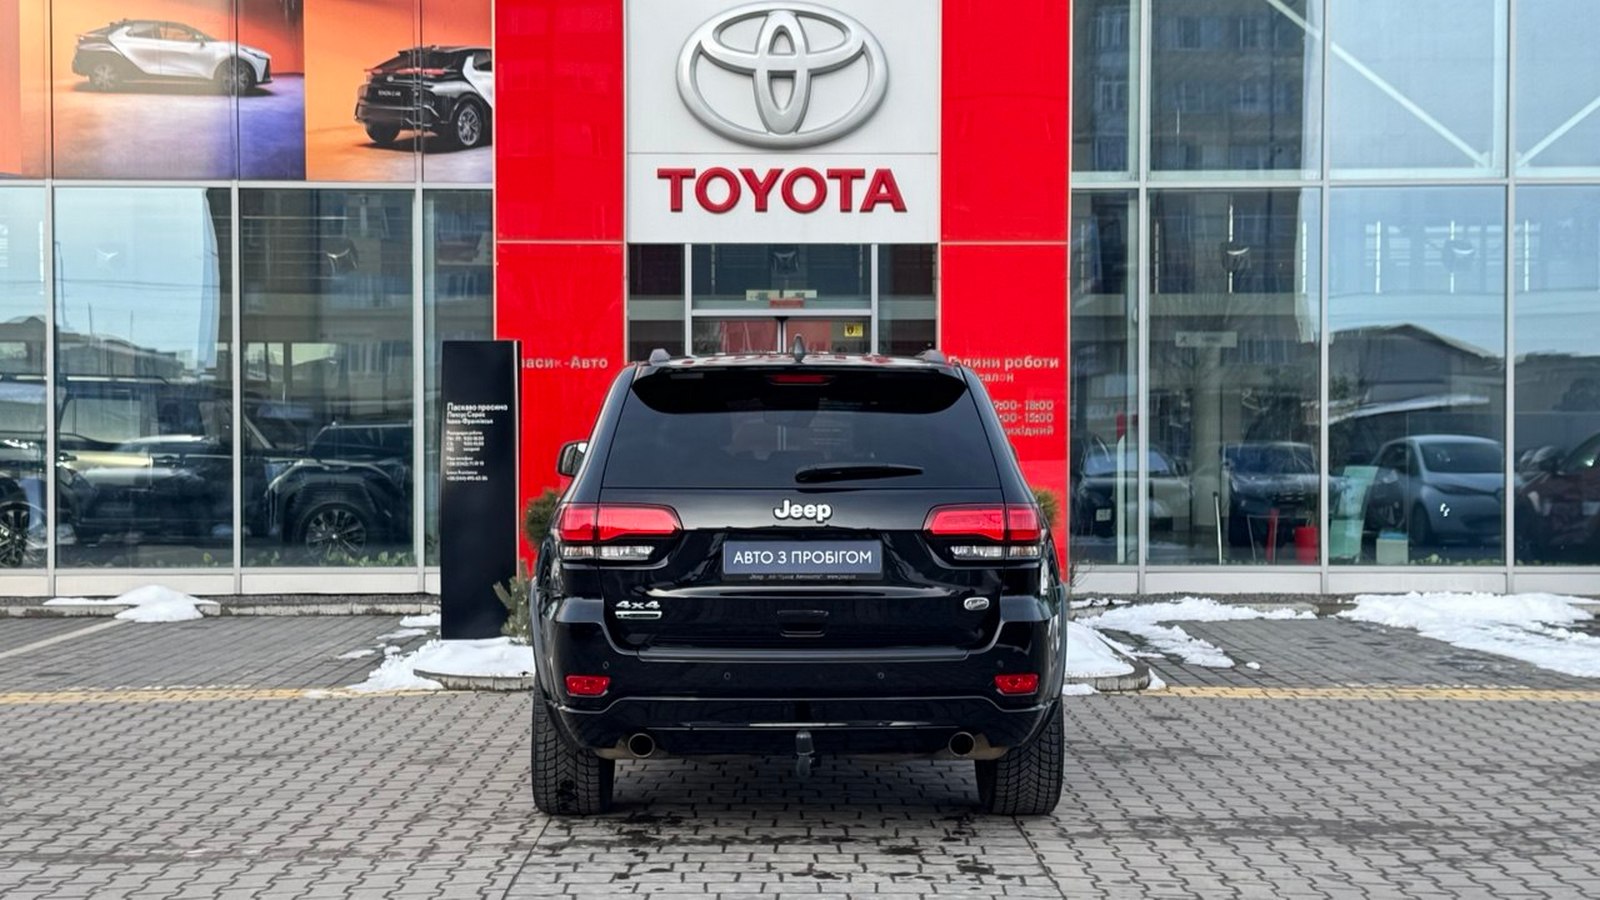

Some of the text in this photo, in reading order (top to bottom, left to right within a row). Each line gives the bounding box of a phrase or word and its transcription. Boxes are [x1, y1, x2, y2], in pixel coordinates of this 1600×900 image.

[657, 167, 908, 215] TOYOTA
[1004, 355, 1059, 371] роботи
[774, 499, 832, 522] Jeep
[733, 551, 774, 564] АВТО
[791, 551, 872, 564] ПРОБІГОМ
[616, 600, 661, 610] 4x4
